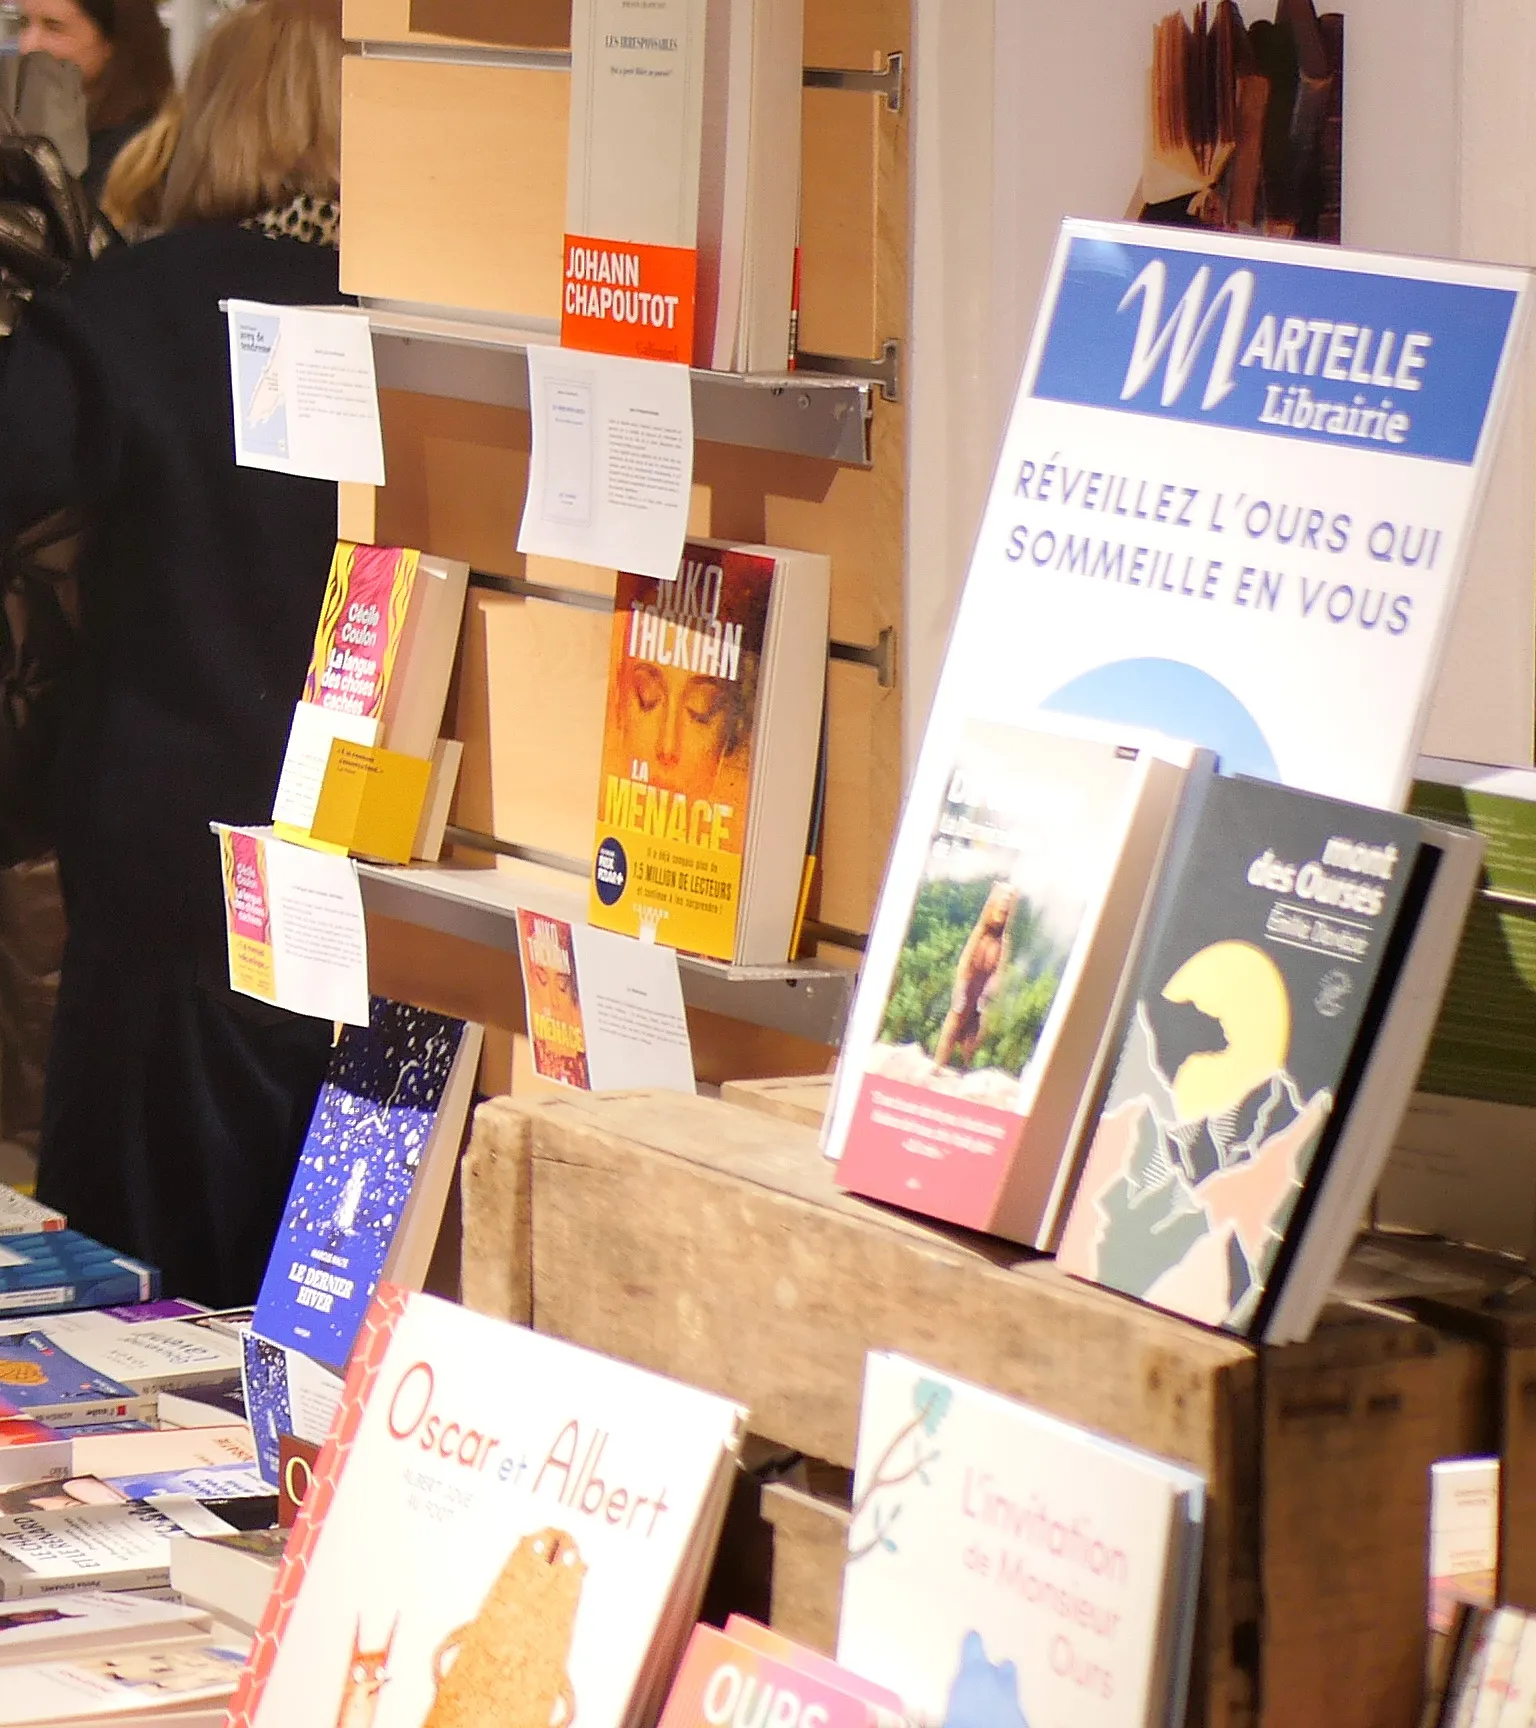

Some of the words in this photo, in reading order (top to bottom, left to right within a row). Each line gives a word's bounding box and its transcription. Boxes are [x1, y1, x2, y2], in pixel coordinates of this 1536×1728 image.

[566, 245, 641, 288] JOHANN
[565, 282, 680, 330] CHAPOUTOT
[1116, 258, 1434, 412] MARTELLE
[1258, 383, 1411, 445] Librairie
[1014, 452, 1199, 528] RÉVEILLEZ
[1208, 489, 1350, 555] L'OURS
[1366, 519, 1442, 571] QUI
[1005, 523, 1223, 603] SOMMEILLE
[1234, 565, 1284, 613] EN
[1298, 577, 1413, 638] VOUS
[631, 758, 650, 782] LA
[604, 773, 735, 854] MENACE
[646, 863, 676, 889] MILLION
[678, 871, 689, 891] DE
[690, 873, 733, 902] LECTEURS
[1246, 847, 1296, 894] des
[288, 1261, 308, 1284] LE
[304, 1267, 355, 1300] DERNIER
[295, 1284, 335, 1314] HIVER
[387, 1360, 501, 1472] Oscar
[499, 1448, 528, 1484] et
[531, 1419, 672, 1540] Albert
[13, 1516, 70, 1550] RENARD
[961, 1465, 1130, 1588] L'invitation
[962, 1541, 991, 1578] de
[993, 1548, 1124, 1642] Monsieur
[1049, 1631, 1116, 1701] Ours
